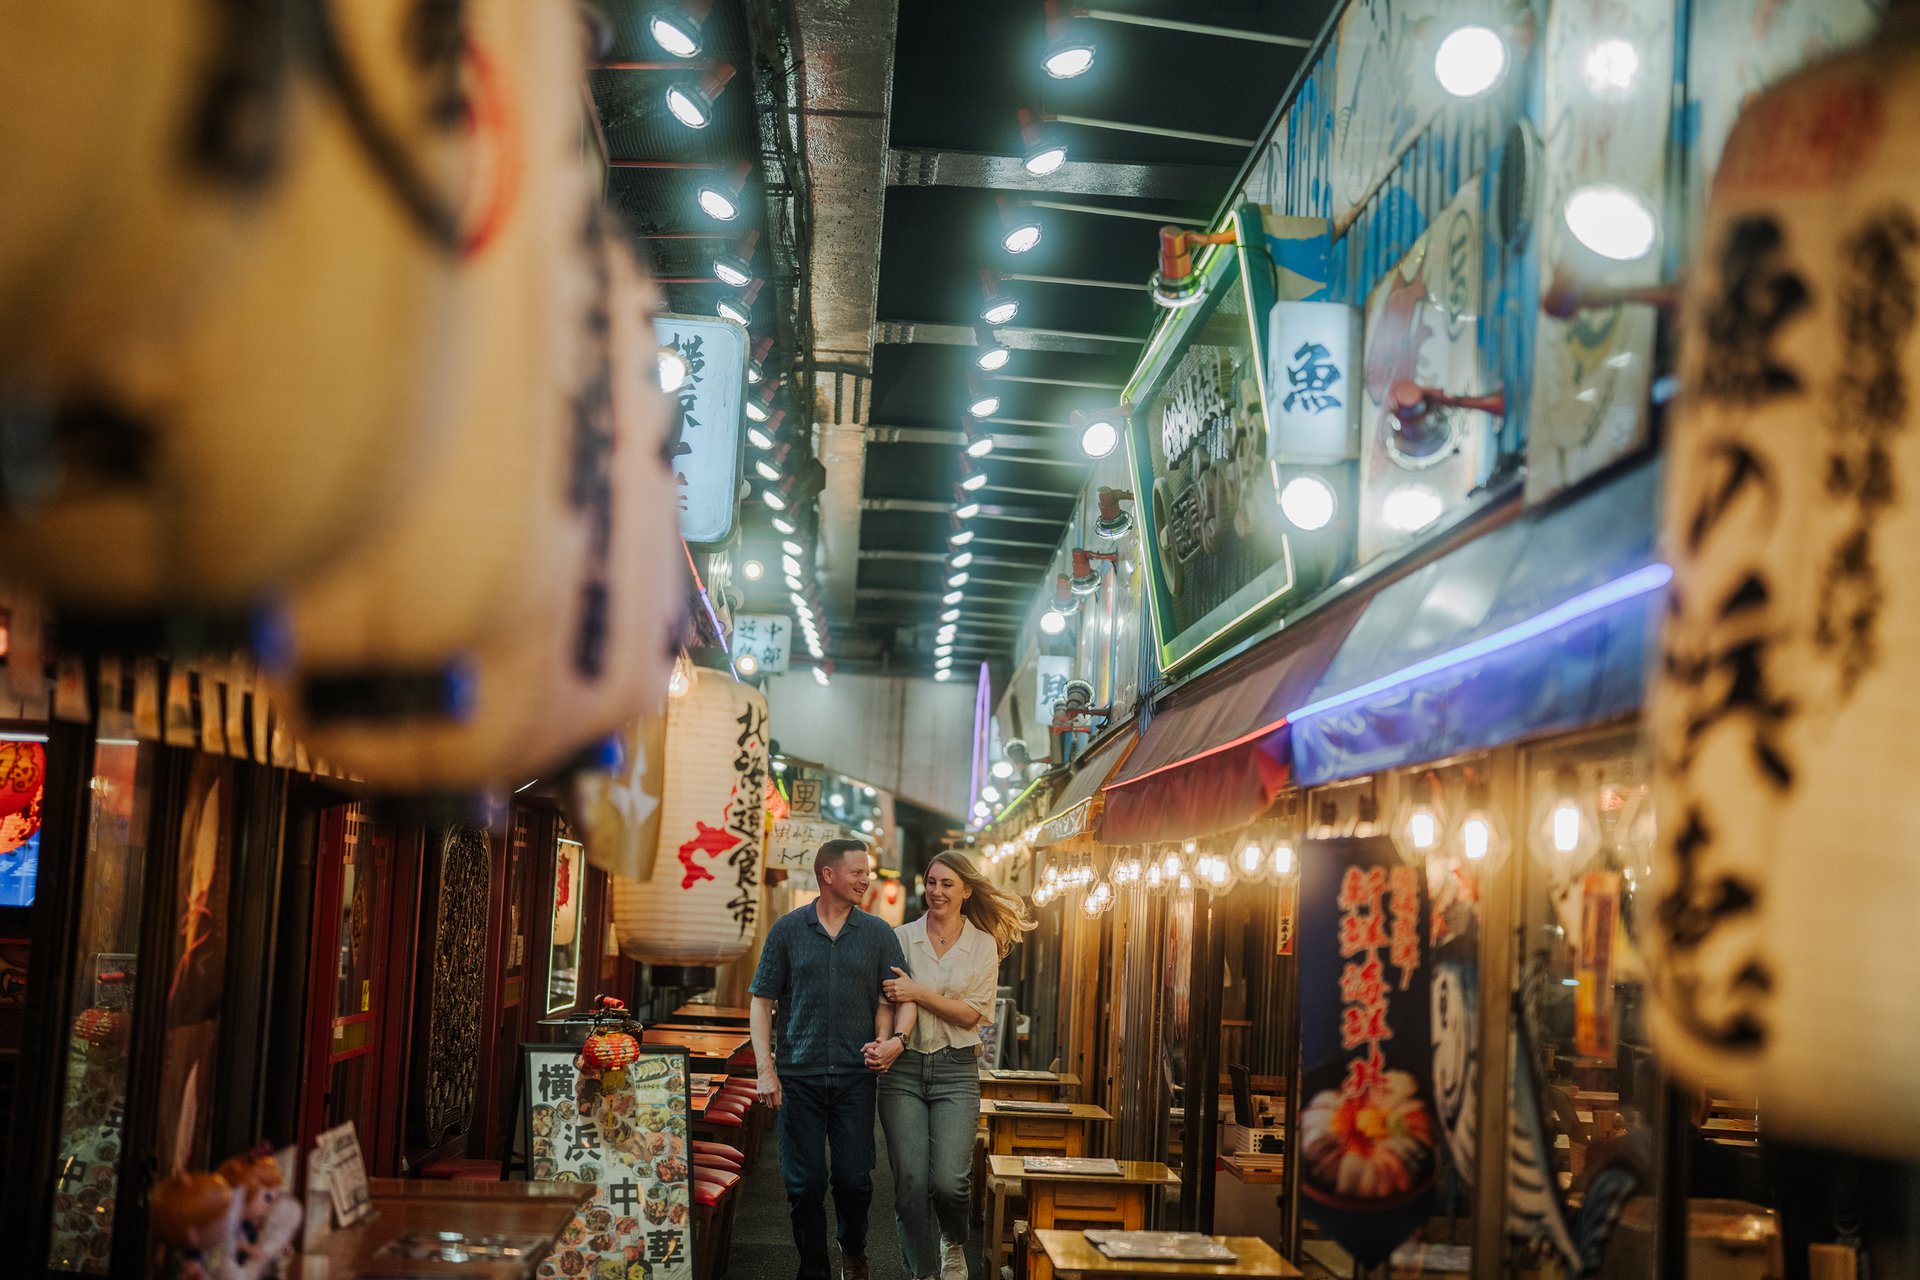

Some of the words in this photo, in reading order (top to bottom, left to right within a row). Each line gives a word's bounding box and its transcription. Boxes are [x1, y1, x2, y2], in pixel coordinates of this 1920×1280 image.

[1282, 341, 1343, 415] 魚
[726, 701, 768, 939] 北海道食市
[794, 784, 816, 813] 男
[538, 1063, 685, 1269] 横浜中華
